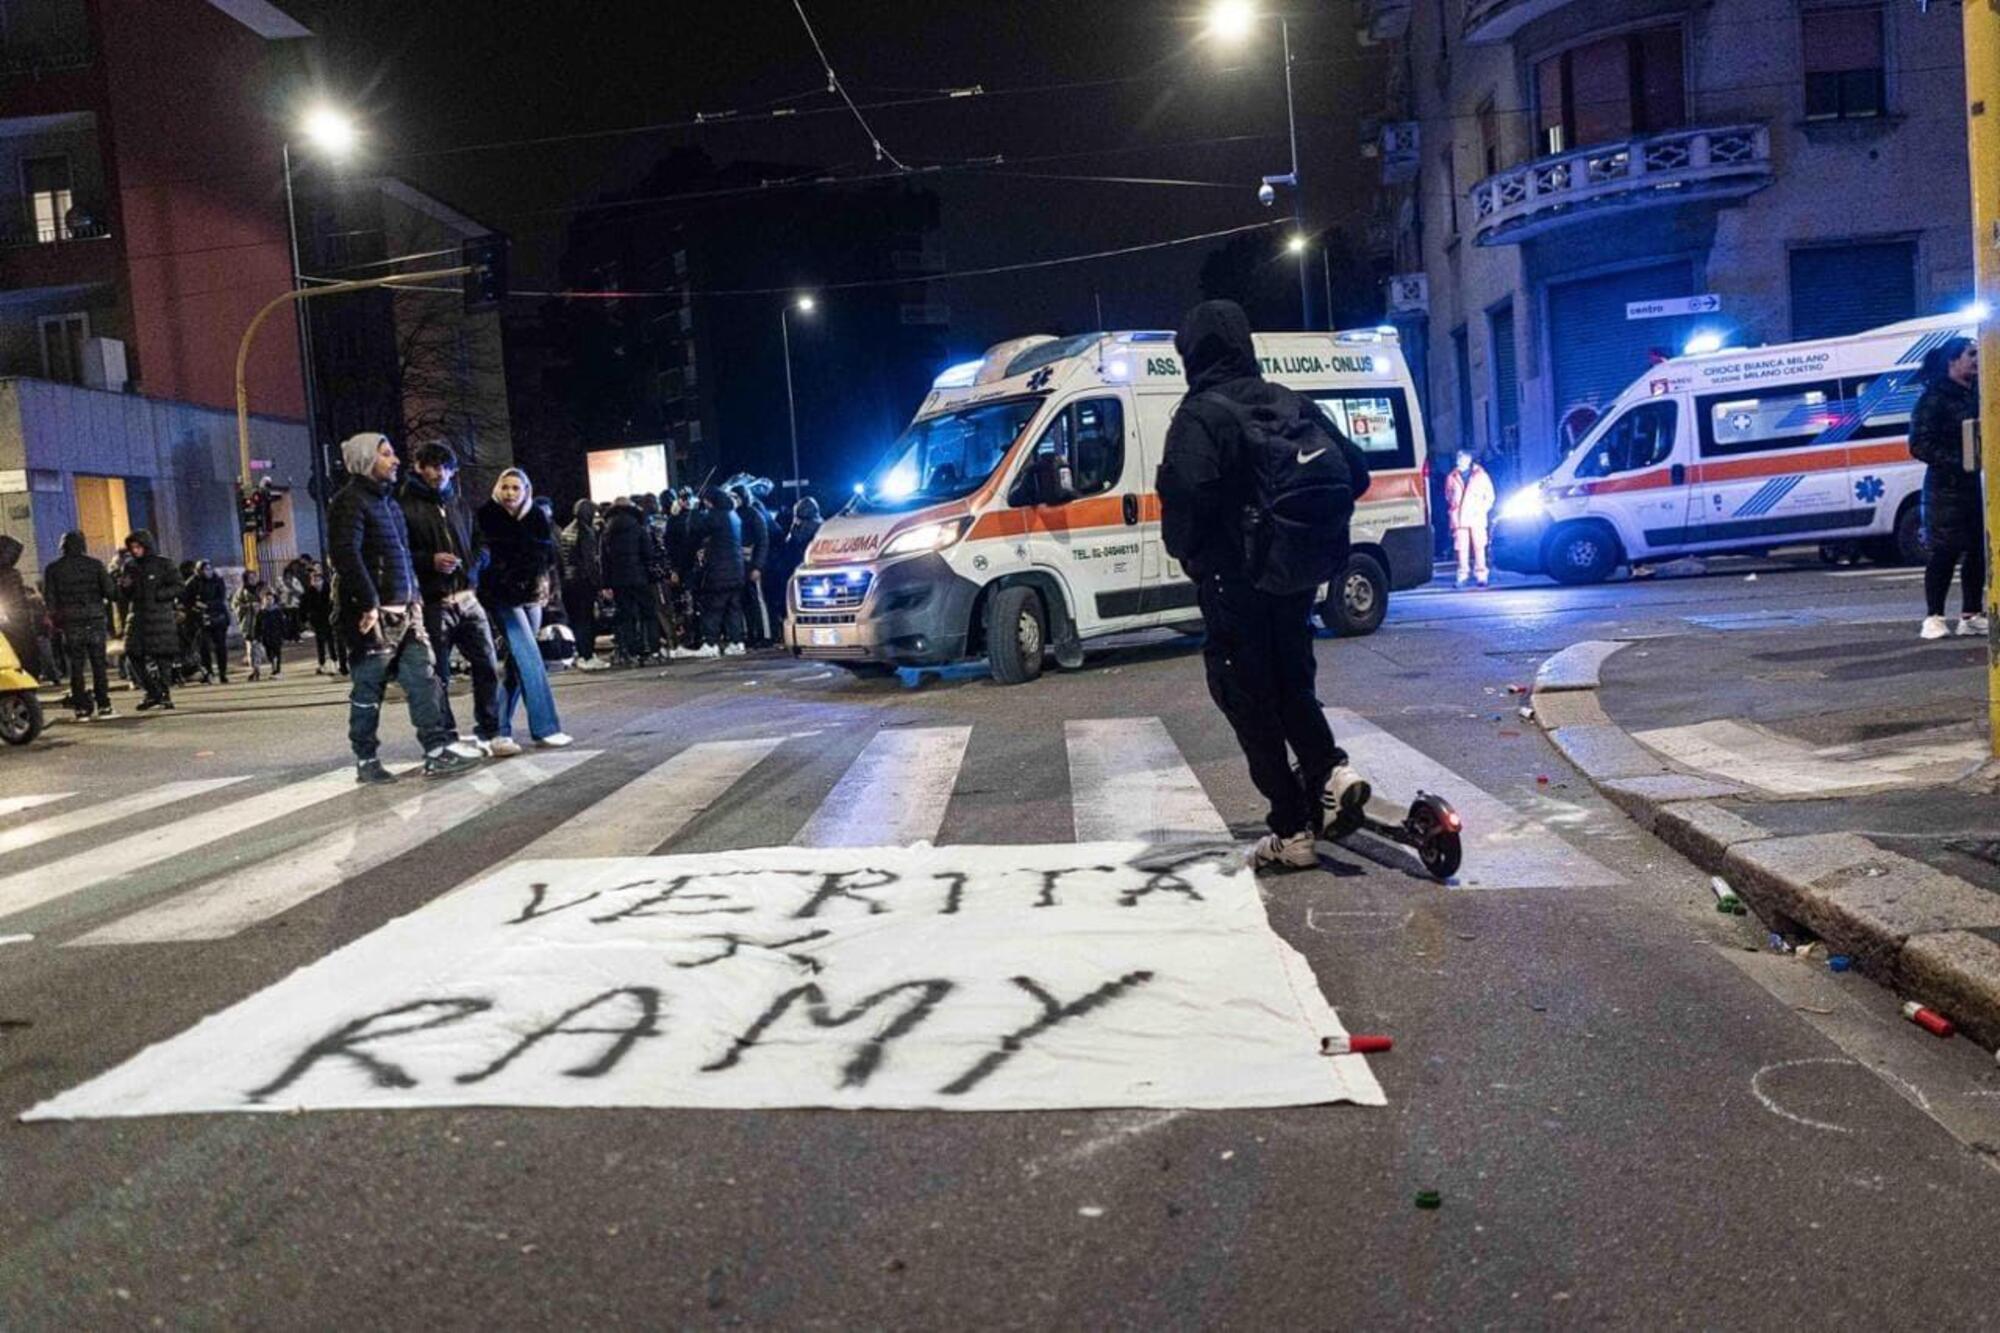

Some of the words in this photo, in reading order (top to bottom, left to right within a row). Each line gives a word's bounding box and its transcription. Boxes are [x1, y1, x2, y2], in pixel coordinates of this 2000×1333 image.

[1629, 304, 1664, 315] centro
[1147, 357, 1181, 375] ASS.
[1283, 356, 1325, 373] LUCIA
[1331, 355, 1373, 373] ONLUS
[1703, 363, 1740, 376] CROCE
[1744, 358, 1785, 371] BIANCA
[1786, 352, 1830, 365] MILANO
[1743, 368, 1781, 379] MILANO
[1783, 363, 1824, 375] CENTRO
[246, 970, 1155, 1103] RAMY
